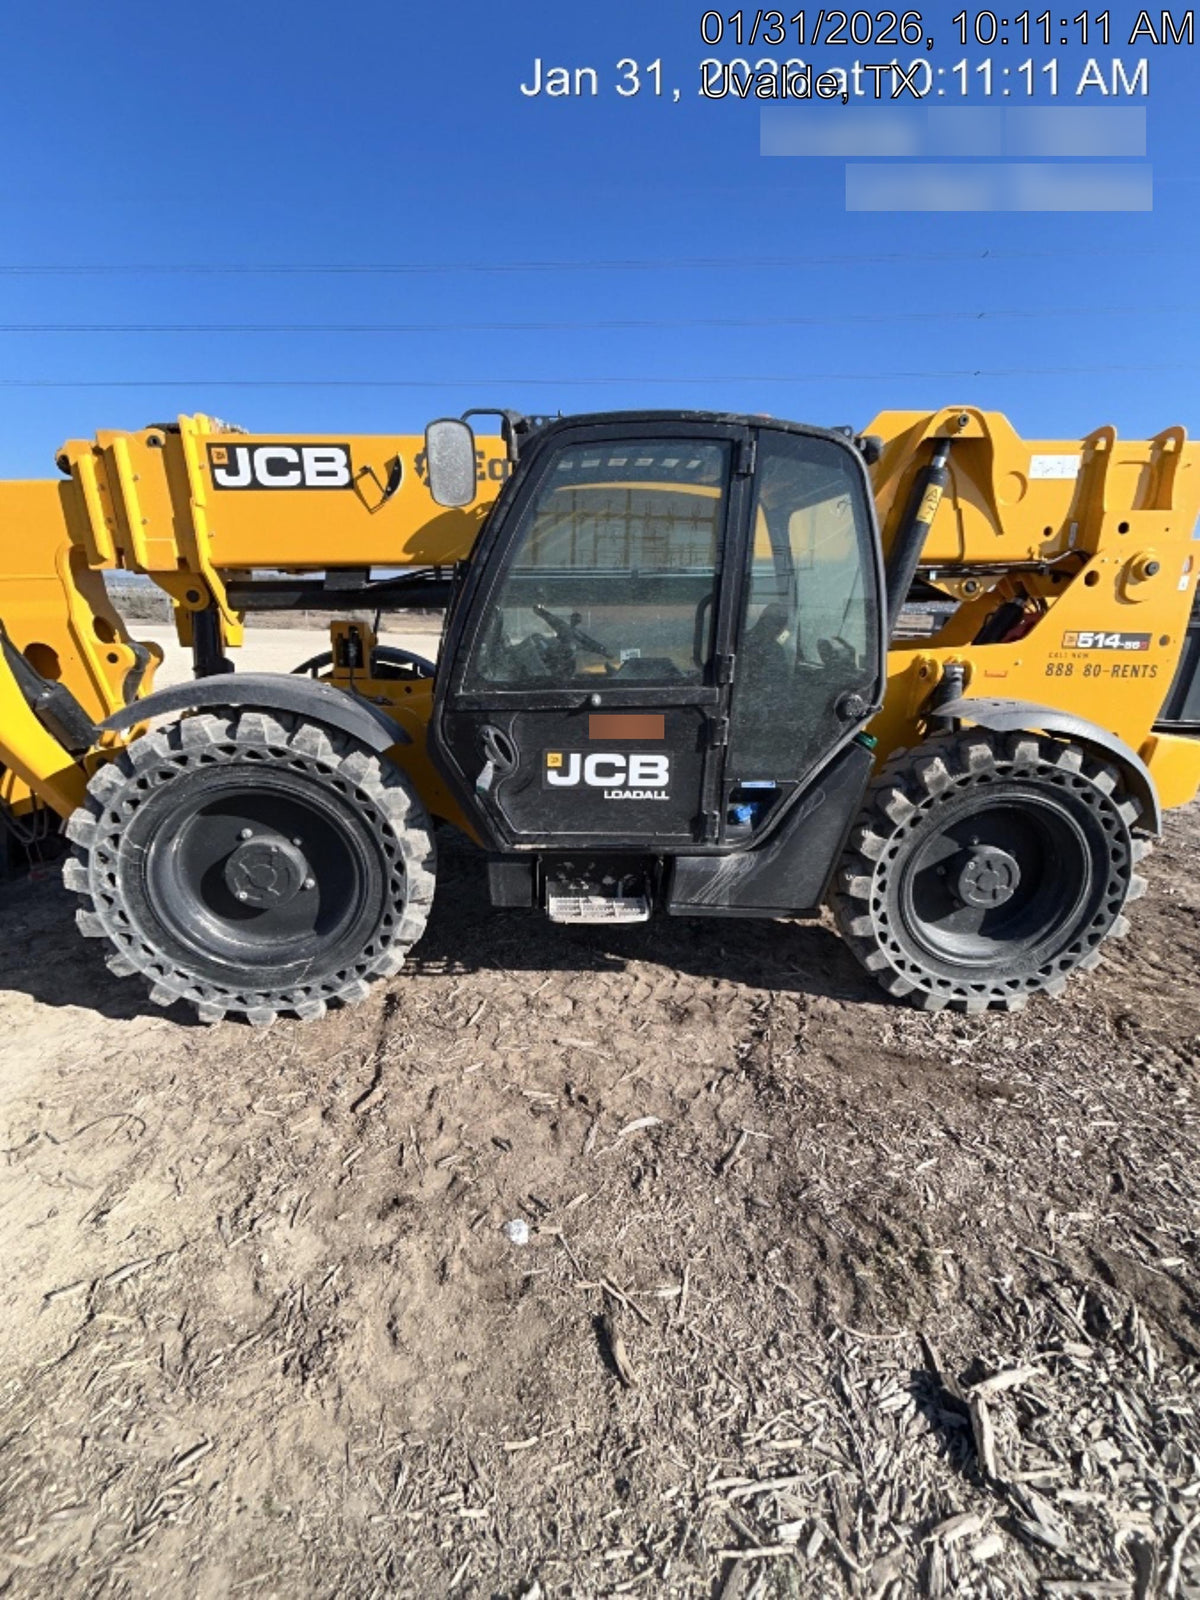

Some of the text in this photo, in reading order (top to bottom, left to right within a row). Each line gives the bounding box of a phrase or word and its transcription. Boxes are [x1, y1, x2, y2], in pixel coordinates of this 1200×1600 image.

[214, 446, 350, 488] JCB
[1045, 662, 1074, 677] 888
[547, 753, 670, 787] JCB
[604, 790, 670, 800] LOADALL
